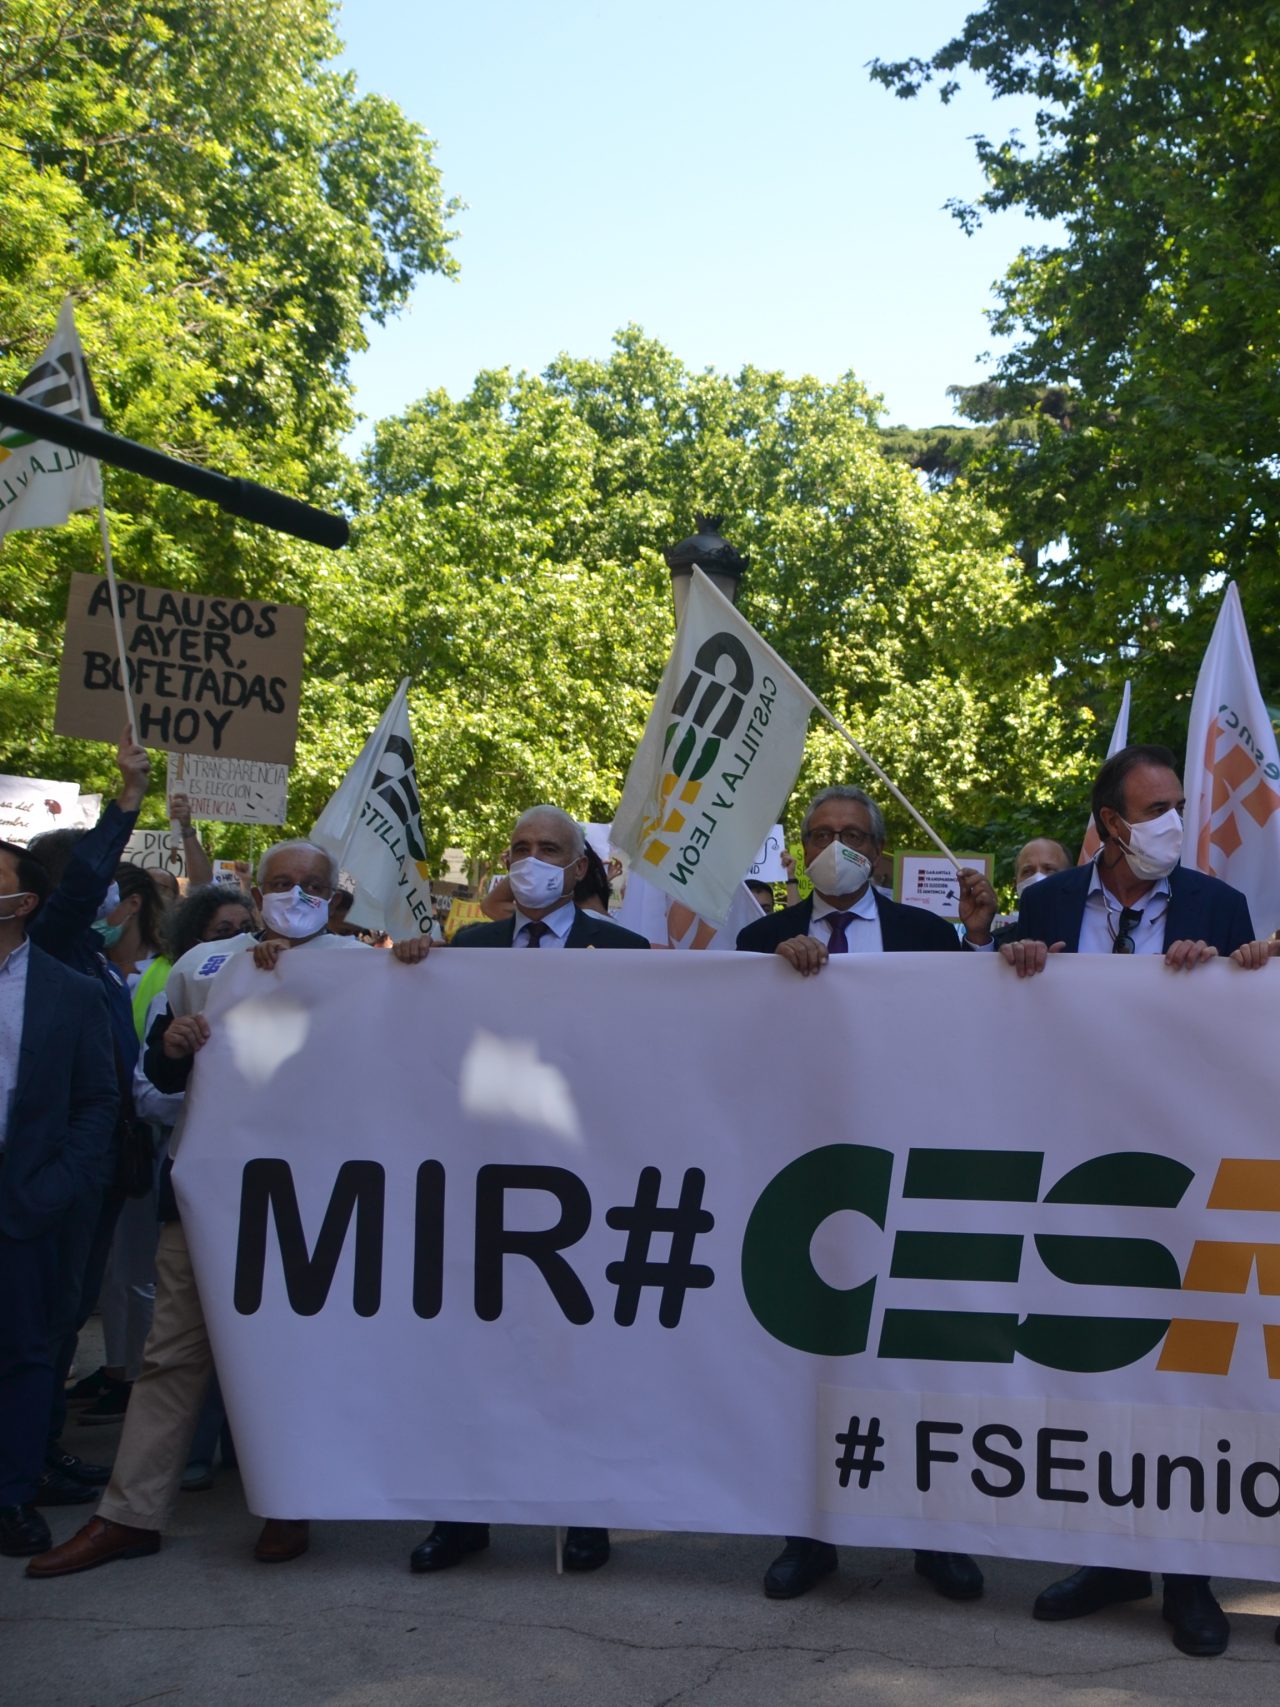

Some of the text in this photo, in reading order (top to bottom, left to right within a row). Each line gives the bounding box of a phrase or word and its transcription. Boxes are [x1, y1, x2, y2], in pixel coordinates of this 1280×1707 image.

[88, 579, 278, 638] APLAUSOS
[129, 624, 247, 669] AYER,
[83, 651, 287, 713] BOFETADAS
[139, 703, 234, 750] HOY
[193, 759, 287, 785] TRANSPARENCIA
[233, 1157, 716, 1329] MIR#
[835, 1416, 886, 1490] #
